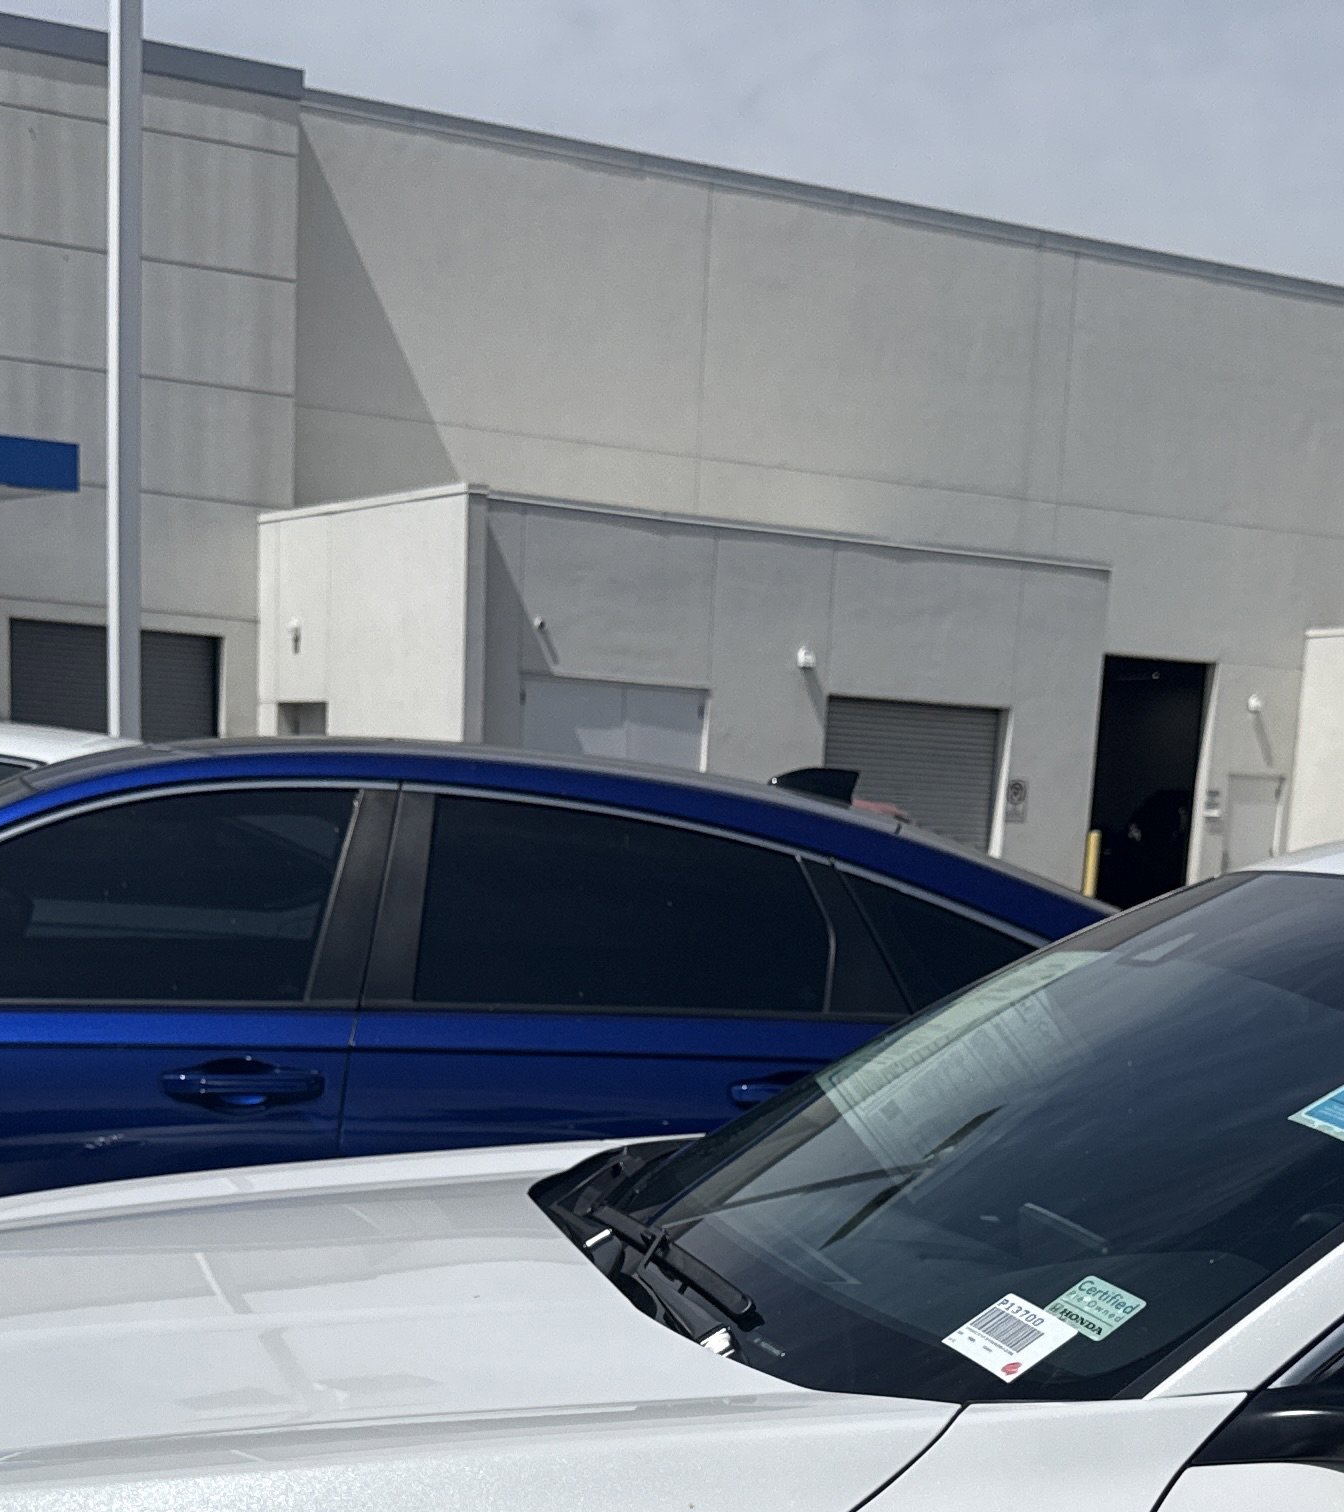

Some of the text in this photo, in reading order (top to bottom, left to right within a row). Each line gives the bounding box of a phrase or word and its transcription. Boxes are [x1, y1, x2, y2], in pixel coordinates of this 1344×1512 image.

[997, 1298, 1045, 1328] P13700
[1065, 1290, 1125, 1324] Pre-Owned
[1077, 1280, 1141, 1316] Certified
[1060, 1307, 1103, 1336] HONDA
